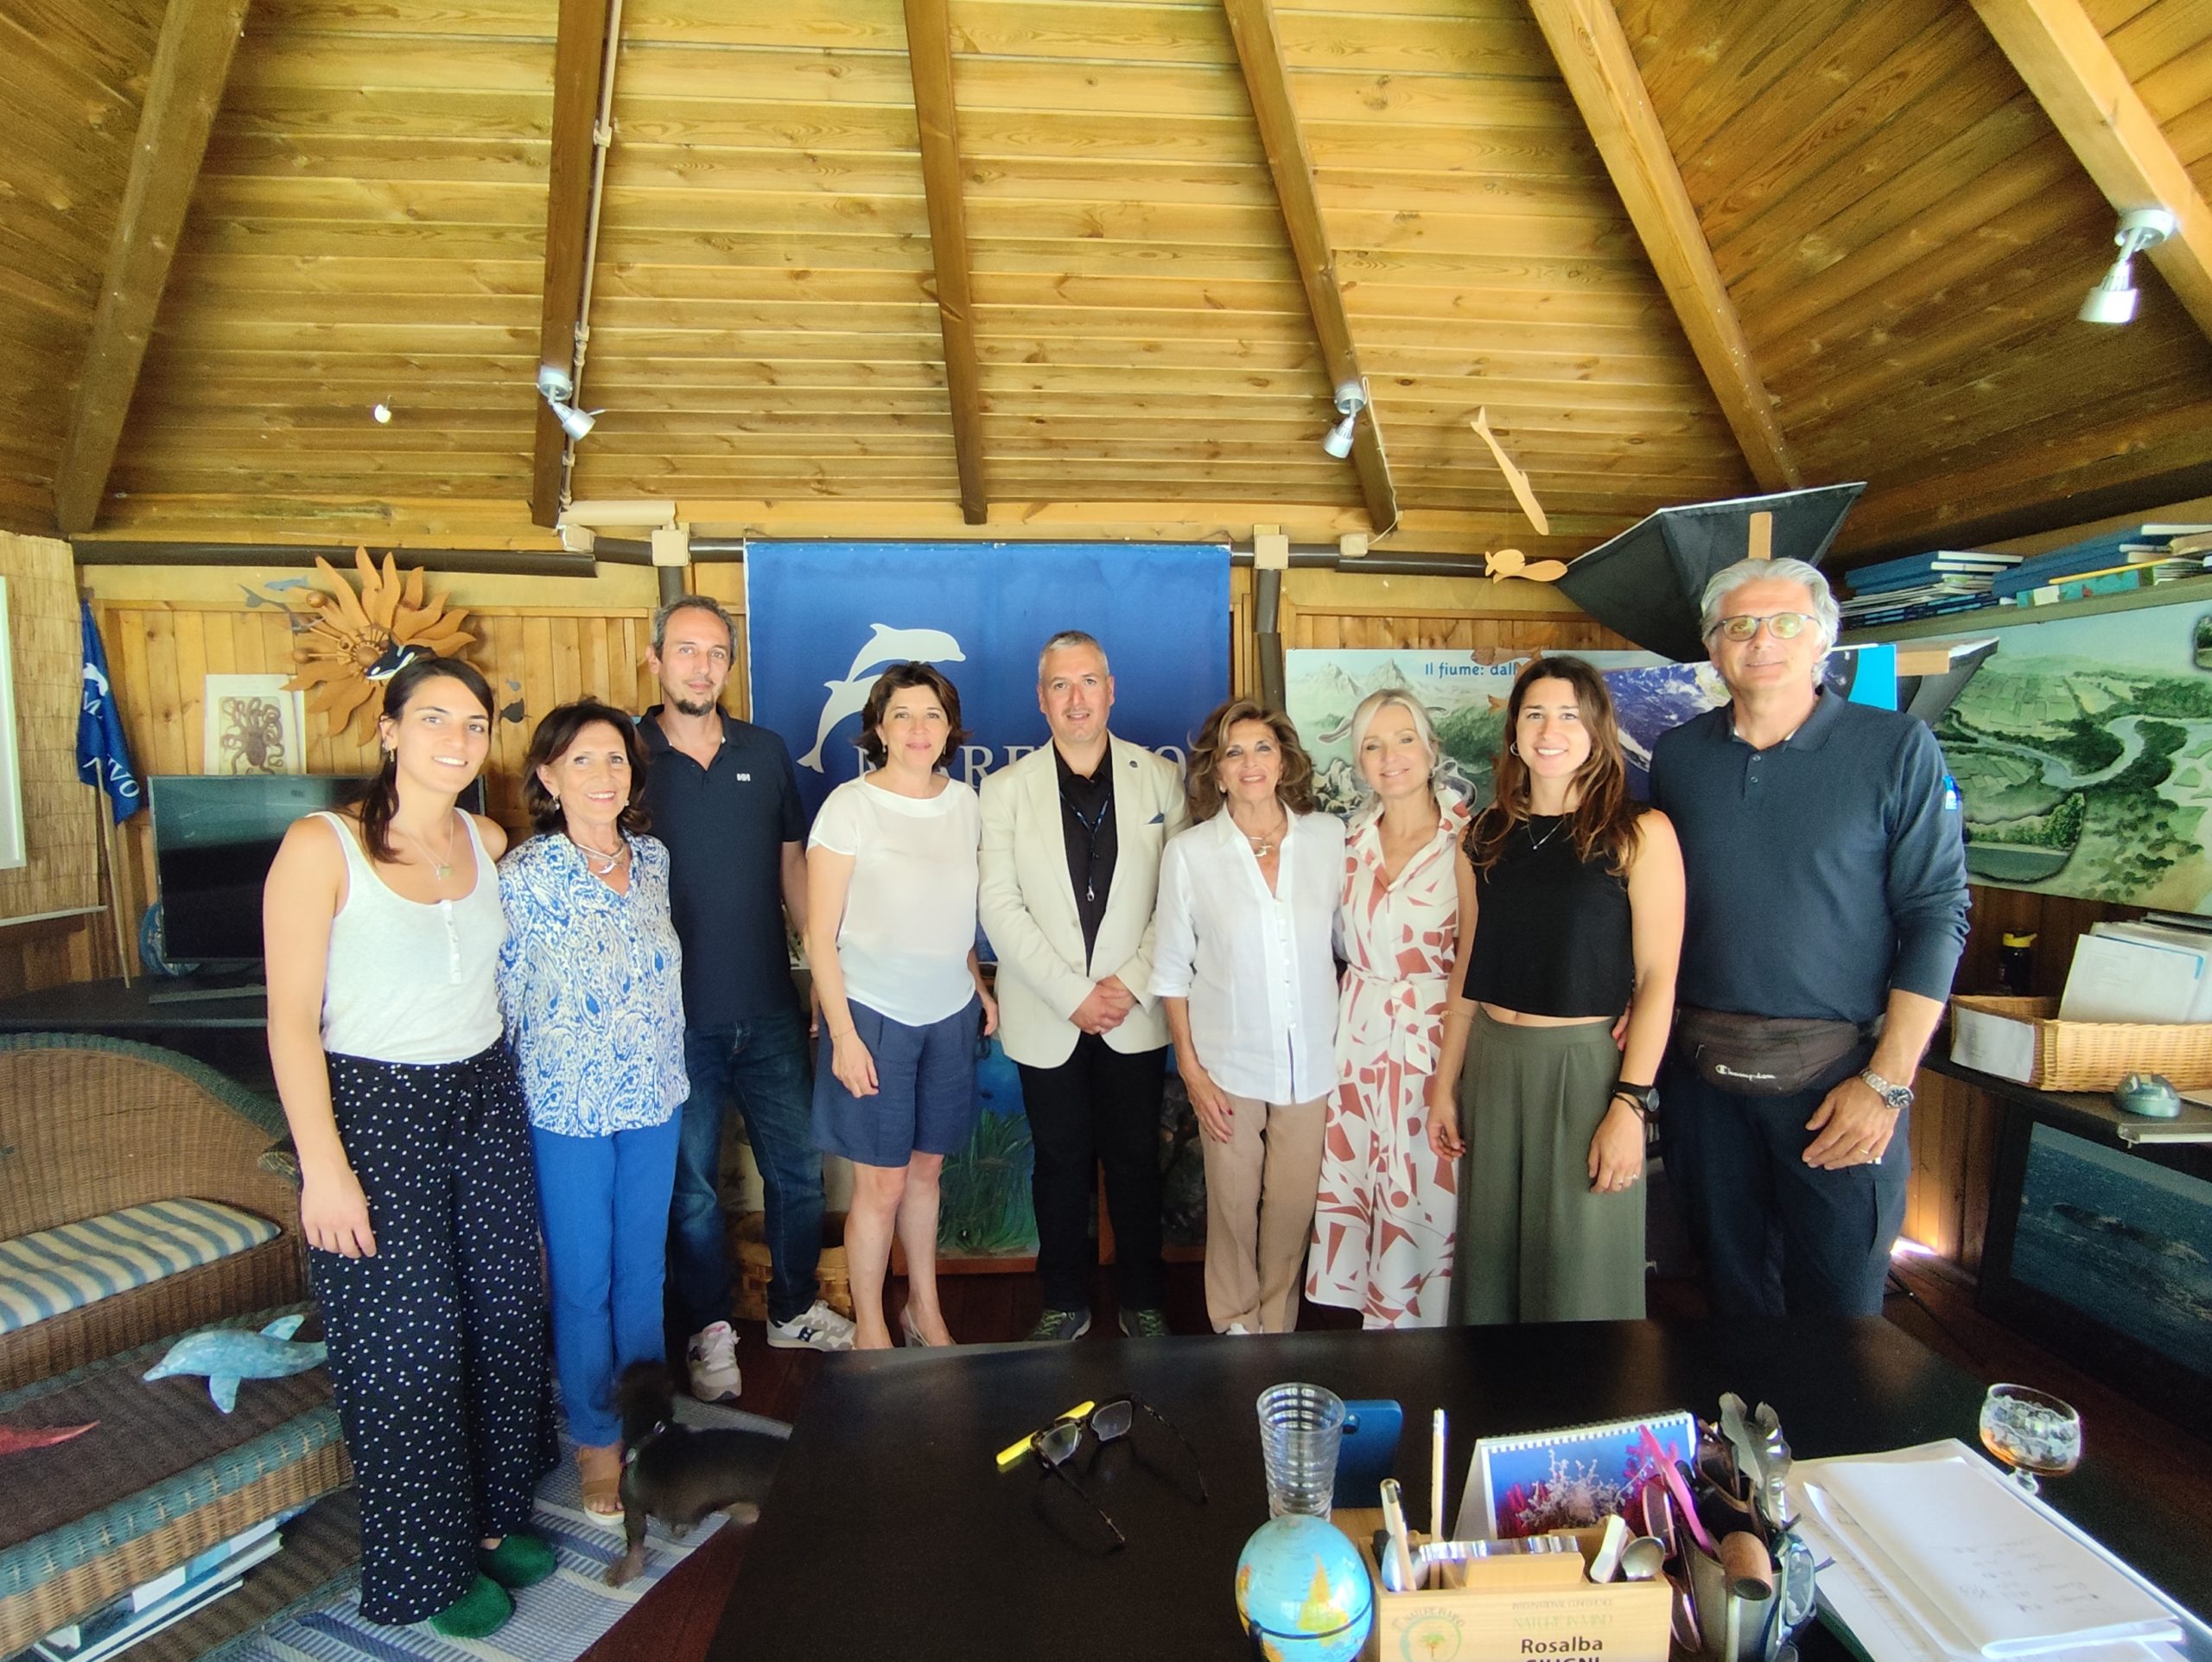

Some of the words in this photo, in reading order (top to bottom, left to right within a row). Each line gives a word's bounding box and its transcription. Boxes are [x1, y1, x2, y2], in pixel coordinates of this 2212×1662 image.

[1425, 662, 1433, 675] Il
[1439, 662, 1484, 678] fiume:
[1521, 1636, 1604, 1654] Rosalba
